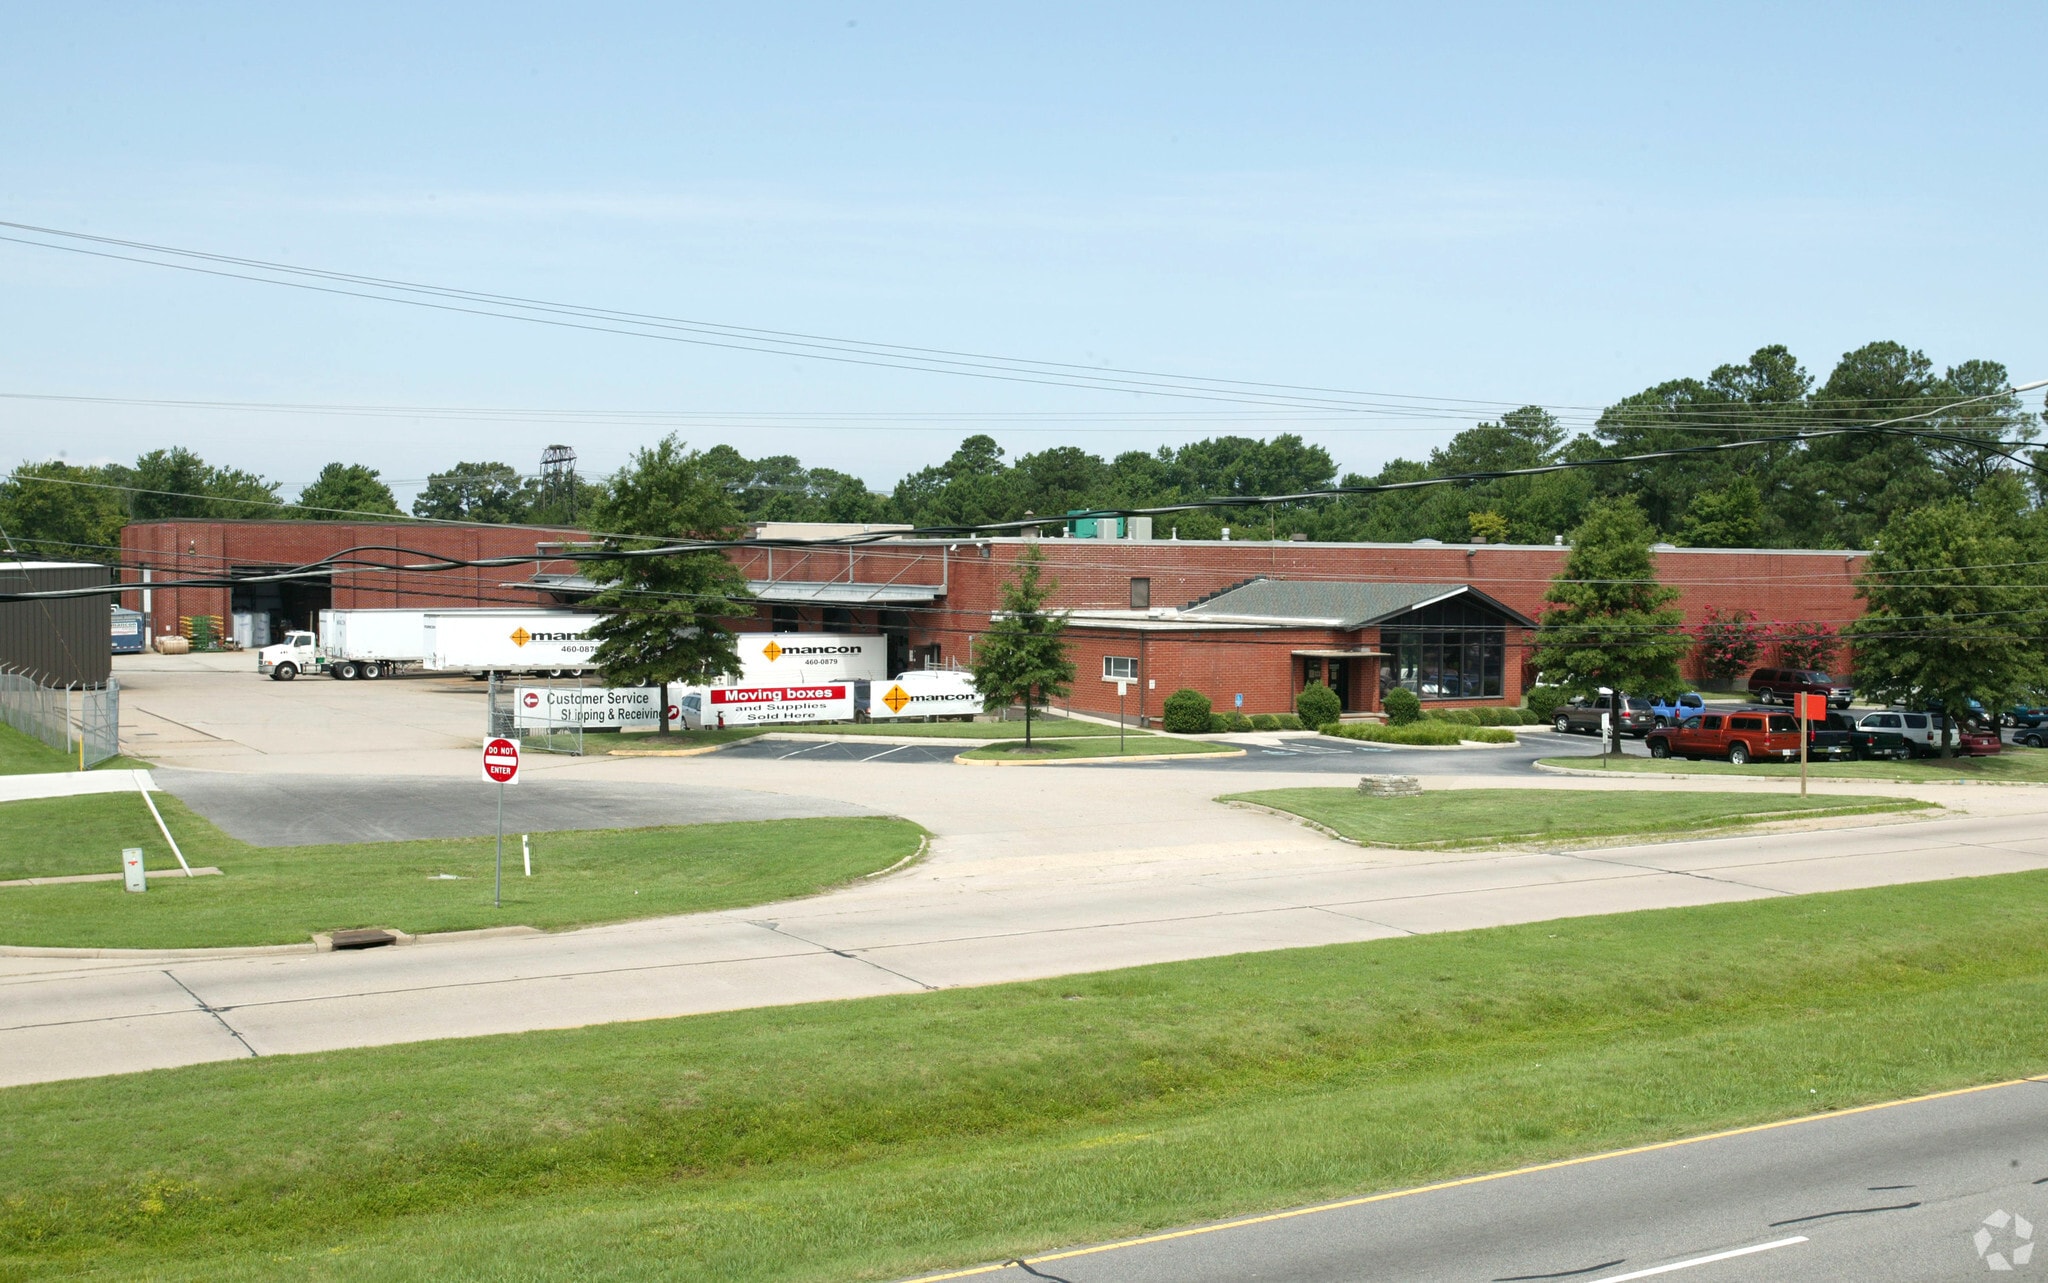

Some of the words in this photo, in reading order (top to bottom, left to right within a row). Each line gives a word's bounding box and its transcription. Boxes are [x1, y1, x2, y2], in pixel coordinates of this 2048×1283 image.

[531, 632, 580, 641] man
[782, 646, 862, 655] mancon
[547, 691, 604, 705] Customer
[607, 691, 649, 704] Service
[725, 689, 782, 702] Moving
[787, 688, 833, 699] boxes
[910, 693, 975, 702] mancon
[766, 702, 827, 711] Supplies
[607, 709, 615, 720] &
[747, 713, 779, 721] Sold
[488, 746, 498, 755] DO
[500, 747, 514, 755] NOT
[490, 766, 511, 775] ENTER
